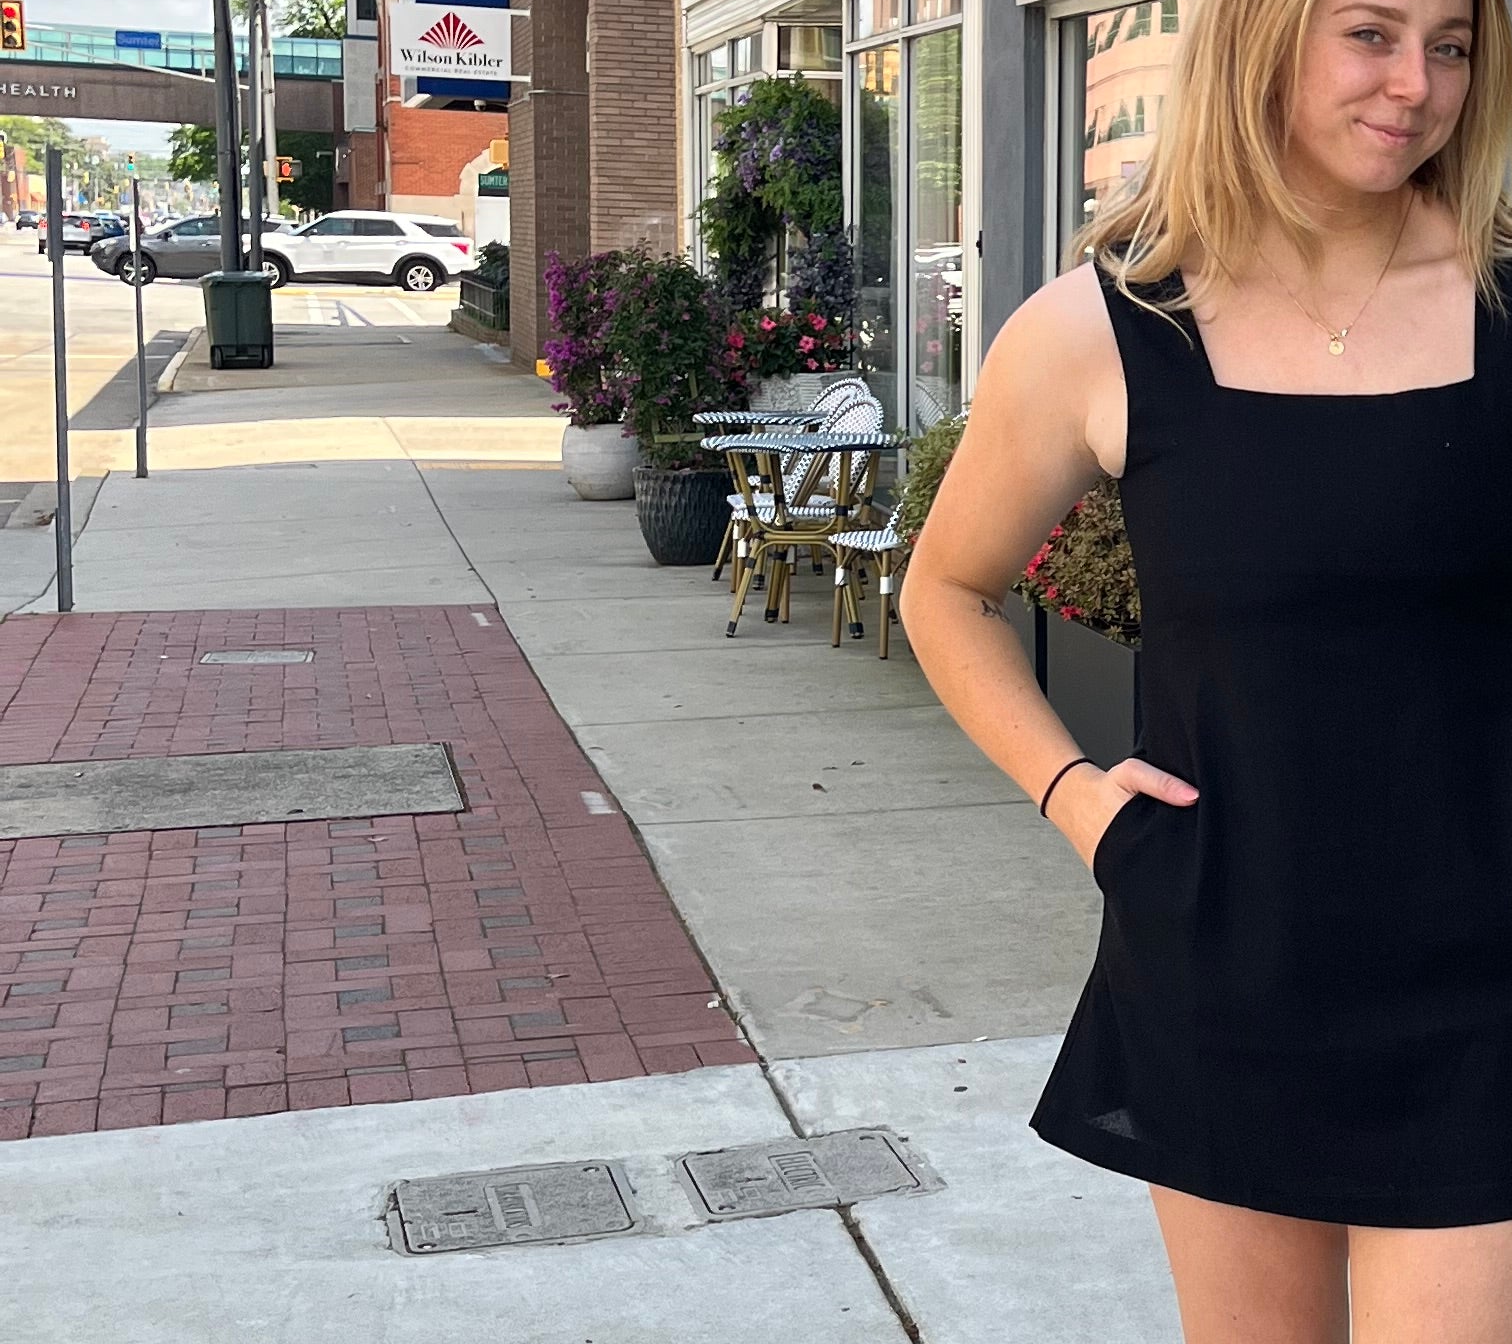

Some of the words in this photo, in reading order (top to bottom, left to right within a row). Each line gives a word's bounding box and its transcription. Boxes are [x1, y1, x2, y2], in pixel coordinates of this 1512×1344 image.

[117, 34, 160, 48] Sumter
[400, 48, 453, 65] Wilson
[456, 51, 503, 68] Kibler
[405, 65, 452, 74] COMMERCIAL
[480, 175, 508, 186] SUMTER
